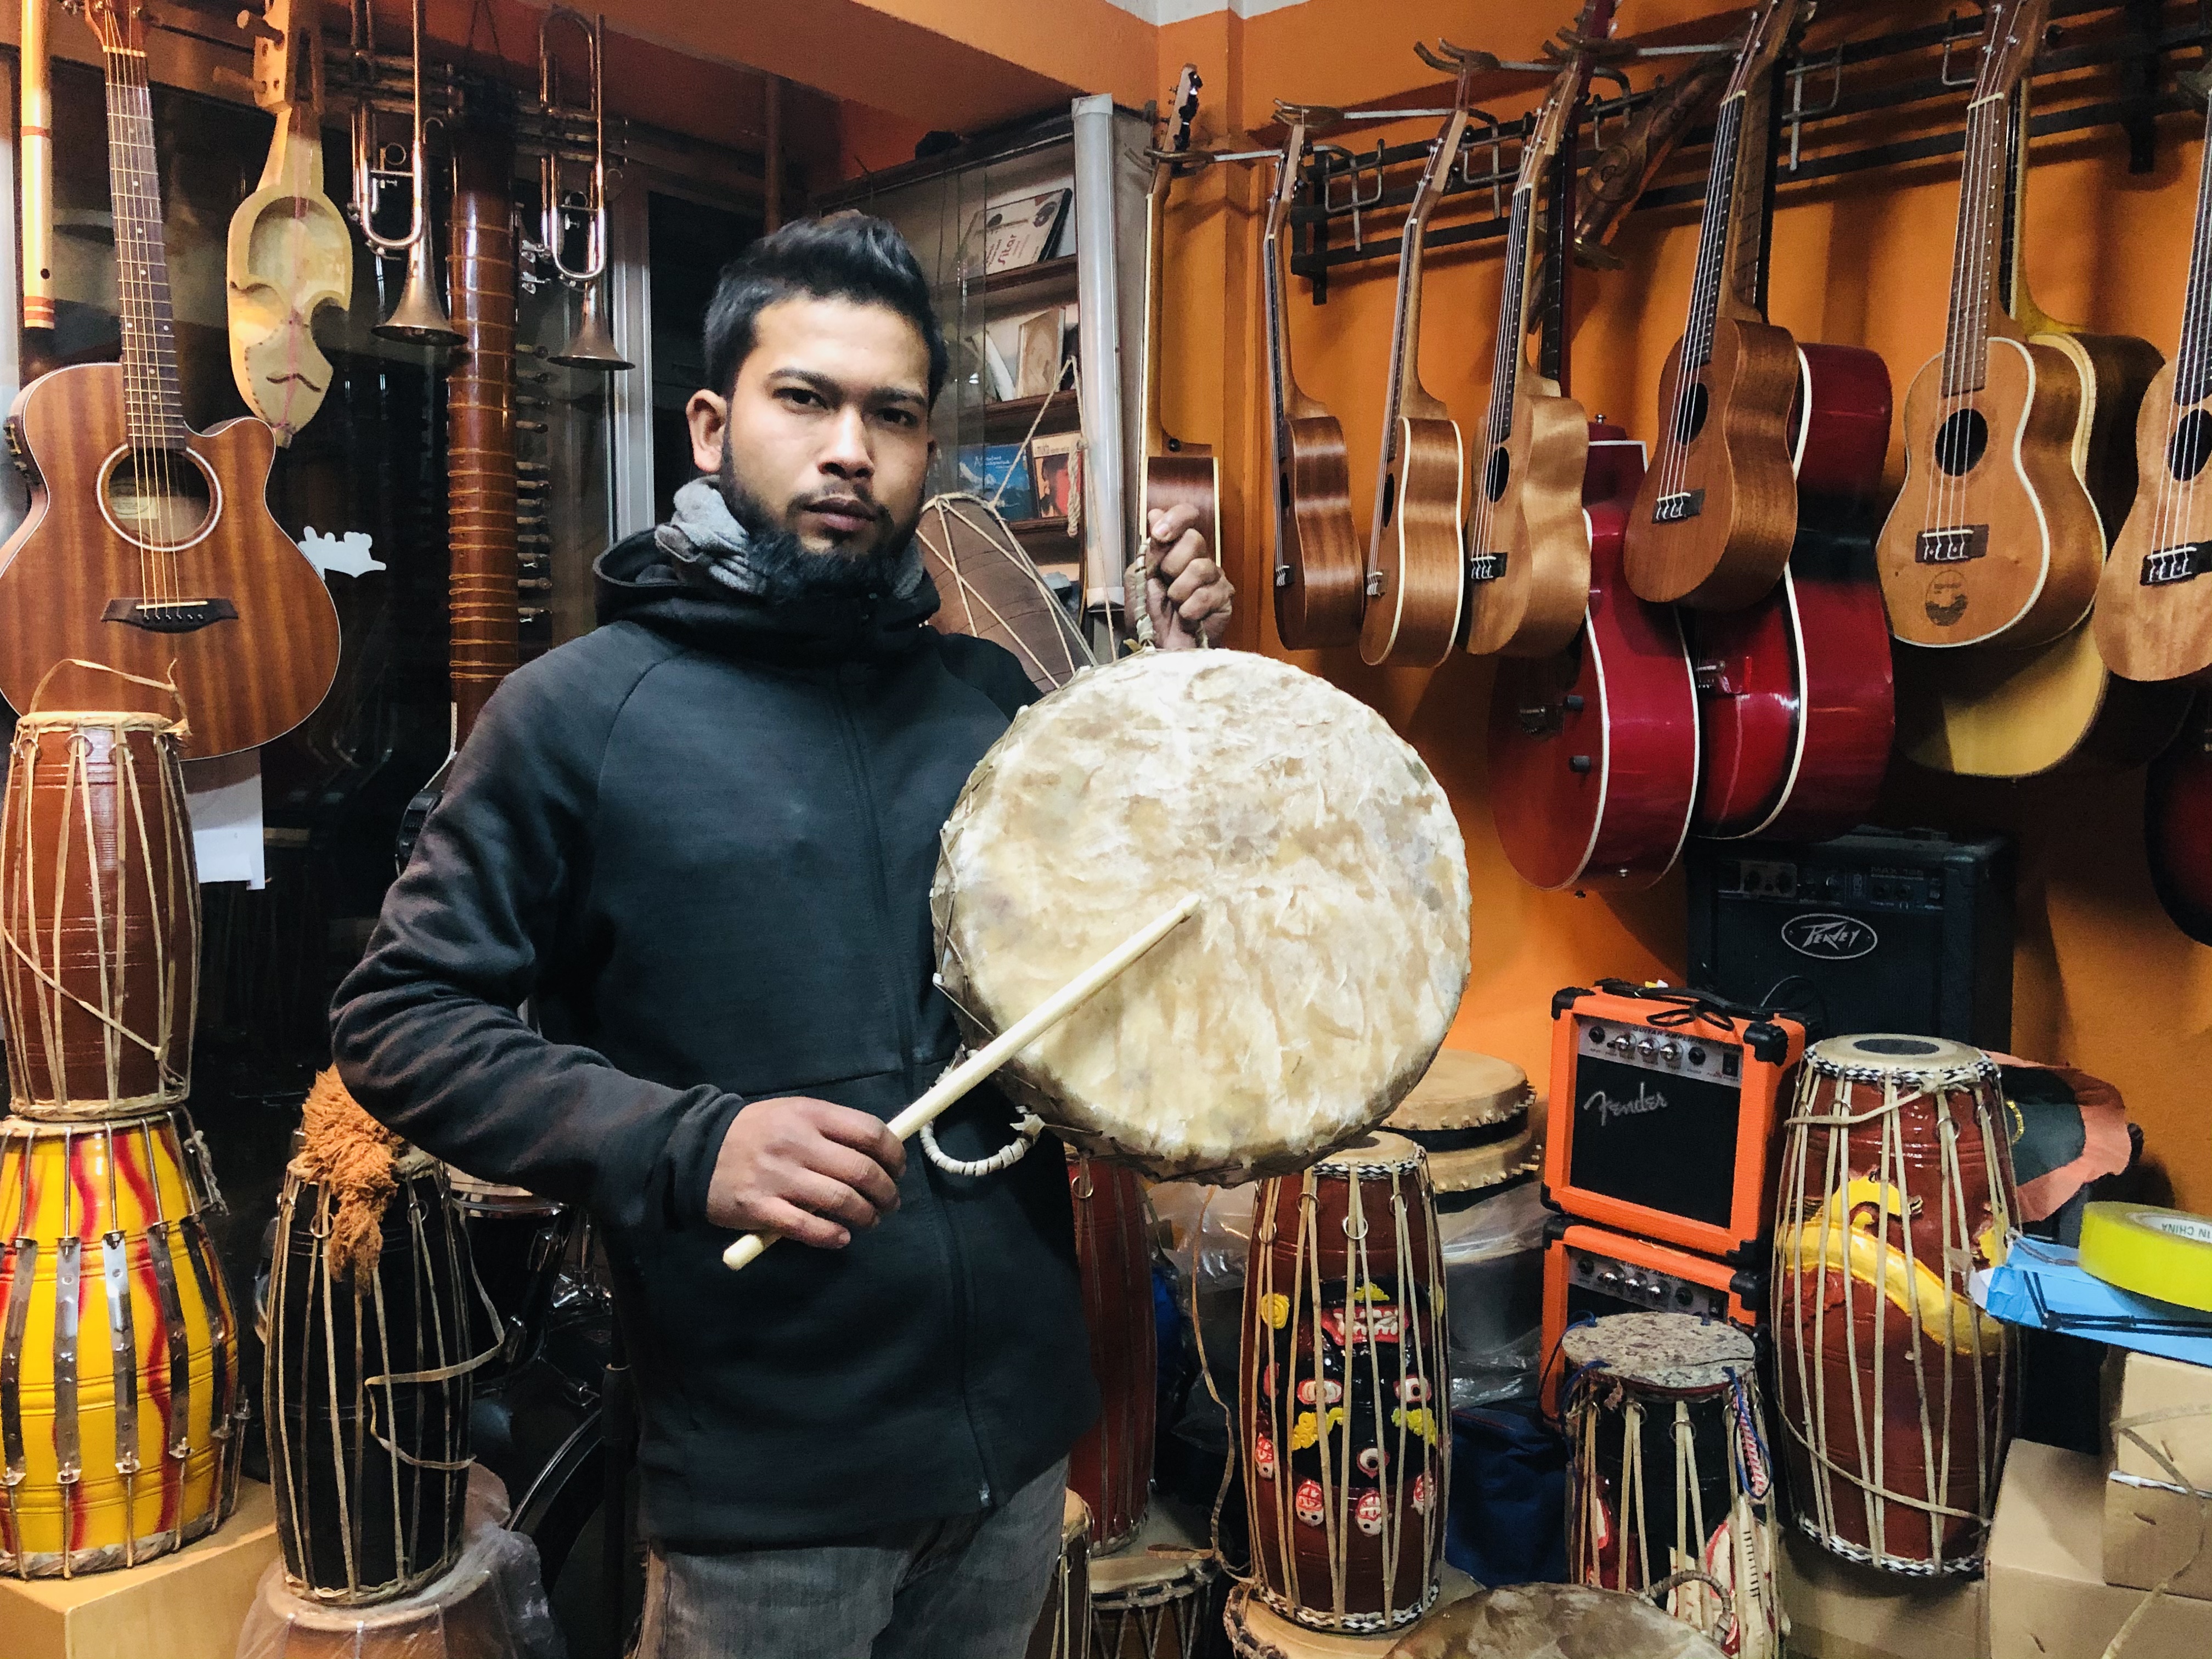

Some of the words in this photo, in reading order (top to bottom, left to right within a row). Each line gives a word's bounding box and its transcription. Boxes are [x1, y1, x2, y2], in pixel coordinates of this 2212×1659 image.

[1632, 1025, 1664, 1037] GUITAR
[1583, 1081, 1668, 1126] Fender
[2161, 1223, 2194, 1236] CHINA
[2198, 1228, 2211, 1239] IN
